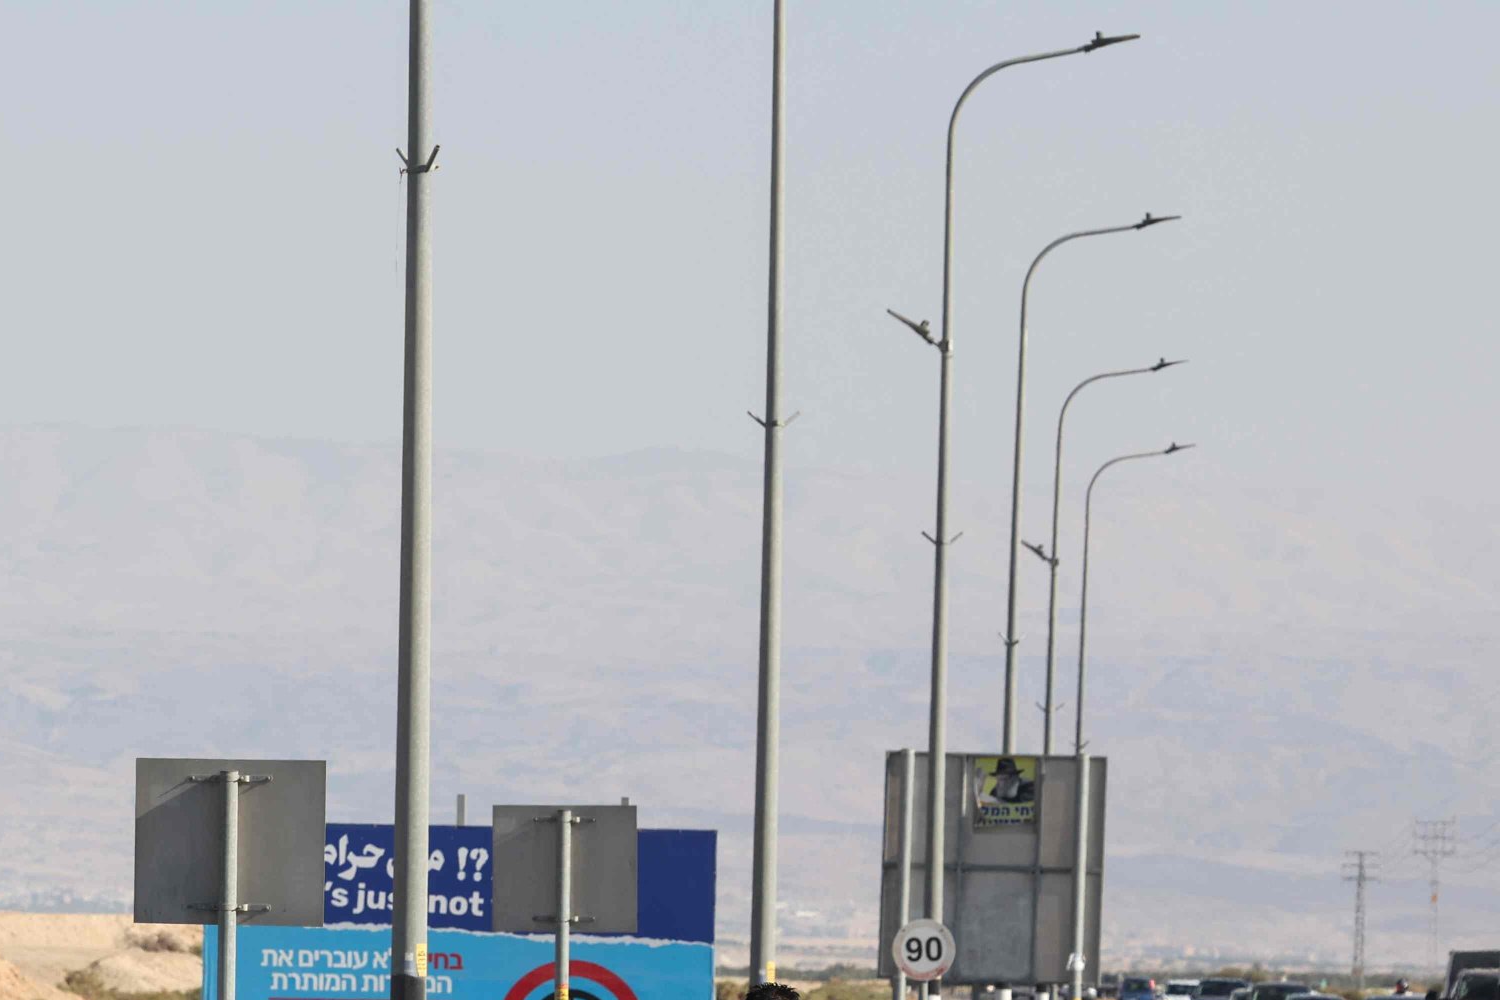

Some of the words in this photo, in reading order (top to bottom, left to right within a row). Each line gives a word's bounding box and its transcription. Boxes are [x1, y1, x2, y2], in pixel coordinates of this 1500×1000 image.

[981, 805, 1010, 817] המל
[352, 882, 393, 915] ju
[428, 891, 485, 917] not
[260, 948, 294, 968] את
[298, 949, 369, 970] עוברים
[906, 936, 943, 962] 90
[427, 952, 464, 970] בחי
[269, 971, 358, 992] המותרת
